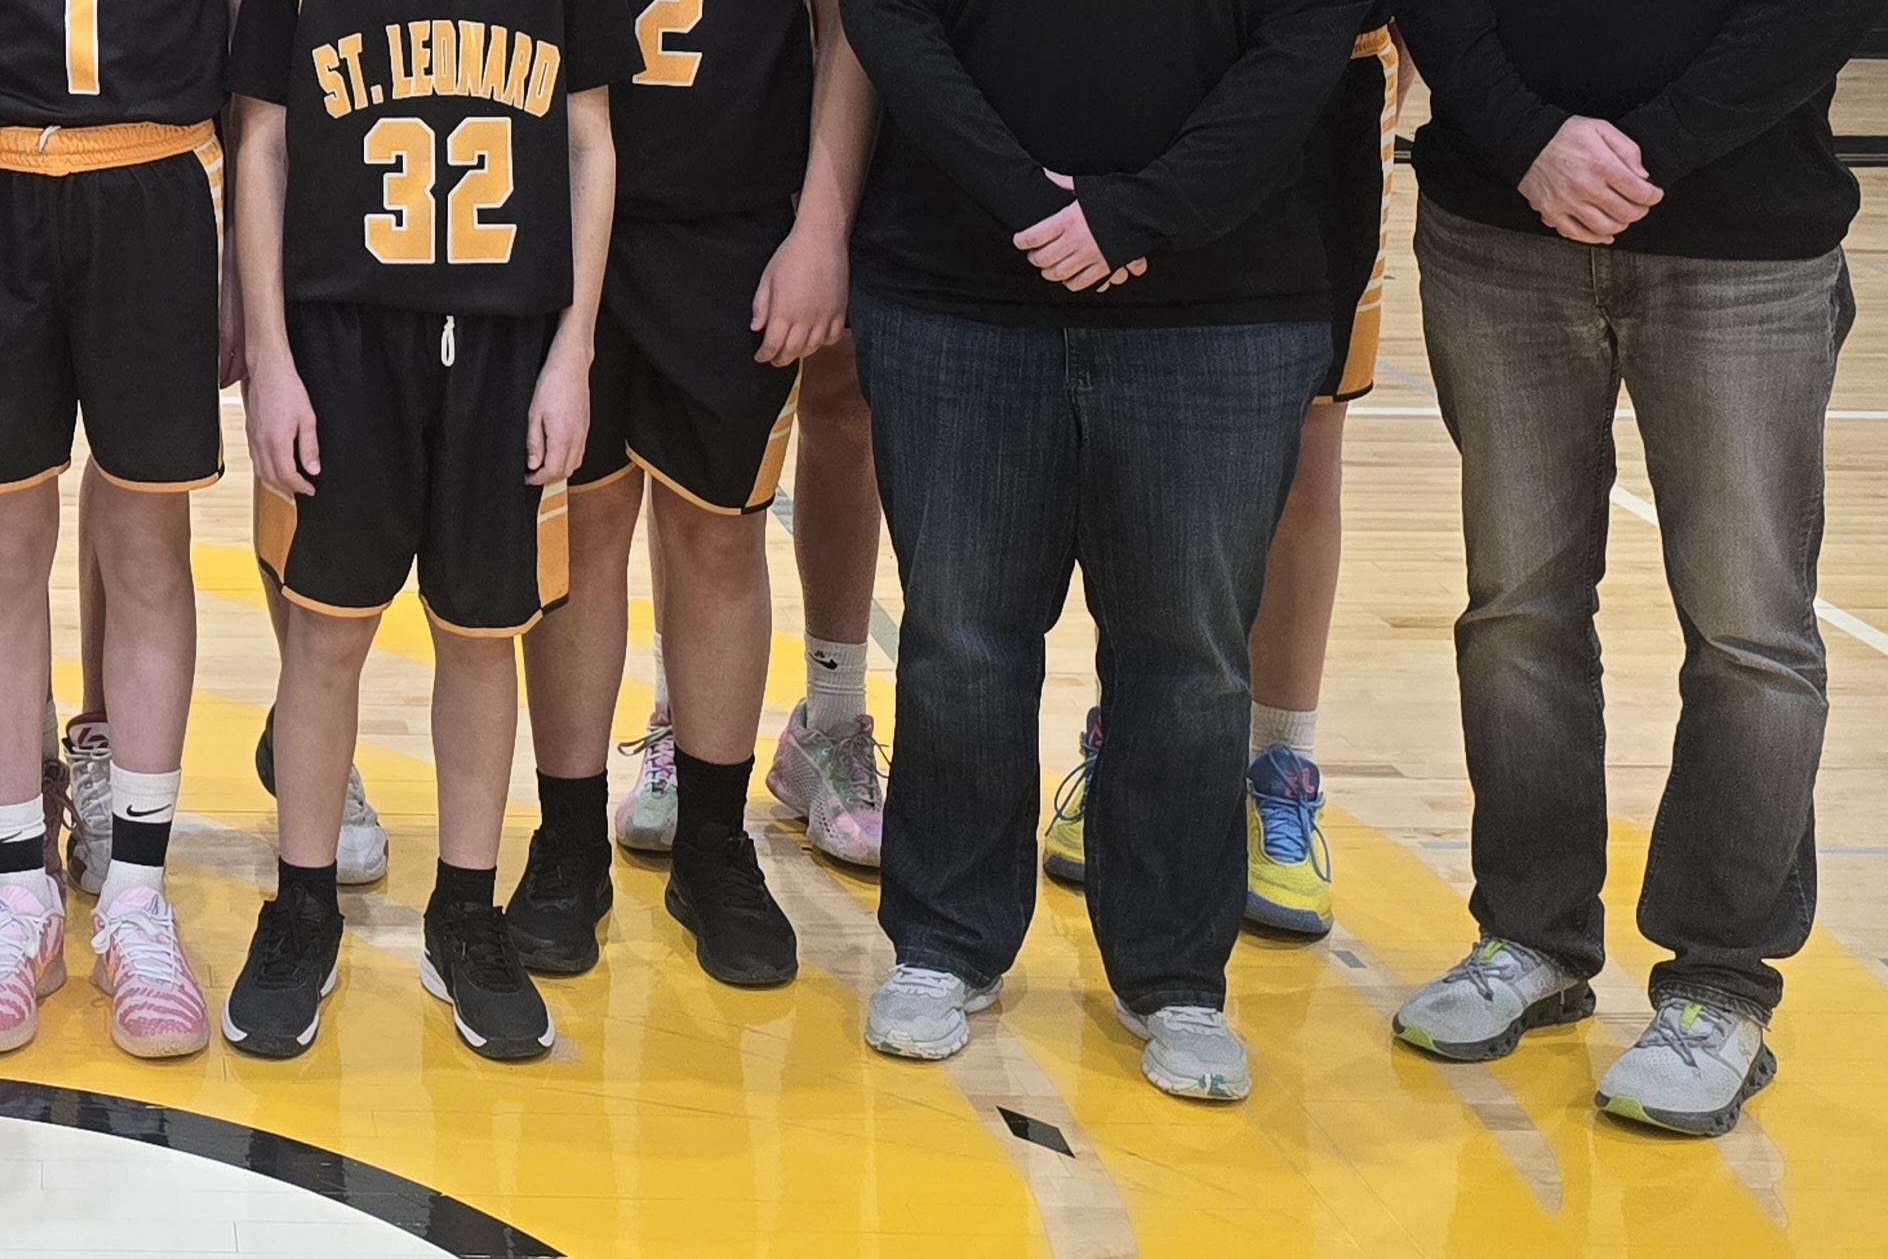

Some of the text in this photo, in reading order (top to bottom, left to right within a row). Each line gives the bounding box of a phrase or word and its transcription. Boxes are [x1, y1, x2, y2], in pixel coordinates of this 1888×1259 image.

[312, 20, 561, 119] ST. LEONARD
[364, 116, 517, 264] 32
